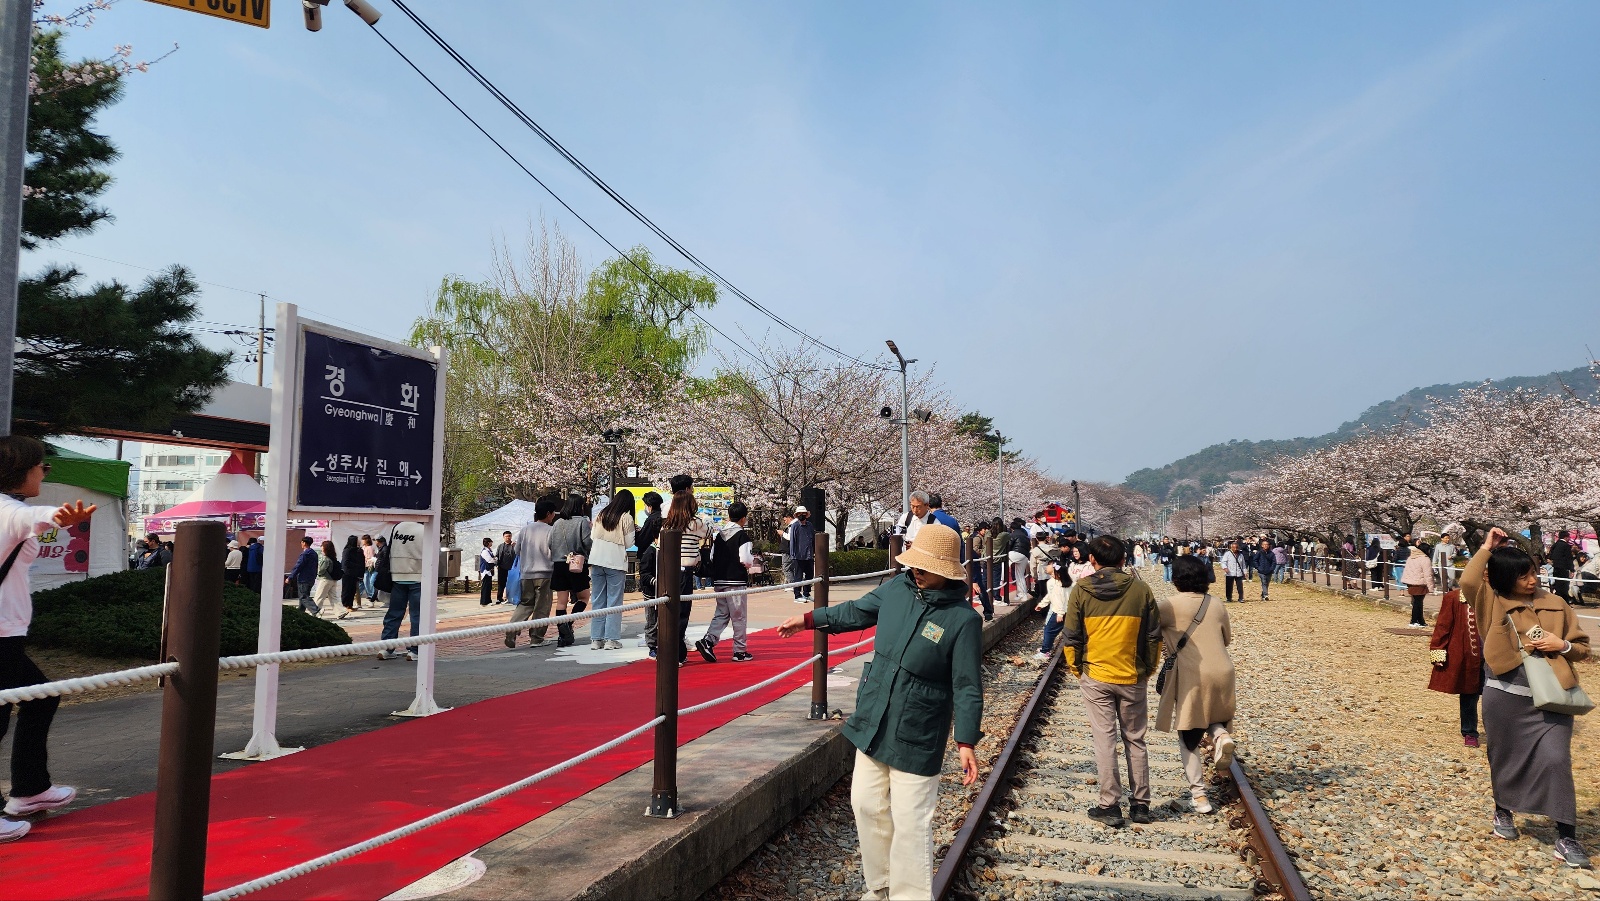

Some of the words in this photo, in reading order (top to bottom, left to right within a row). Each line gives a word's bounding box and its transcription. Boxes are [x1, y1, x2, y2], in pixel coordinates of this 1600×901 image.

[324, 364, 345, 397] 경
[400, 382, 420, 412] 화
[324, 403, 379, 423] Gyeonghwa
[326, 453, 368, 473] 성주사
[376, 458, 387, 475] 진
[399, 460, 409, 477] 해
